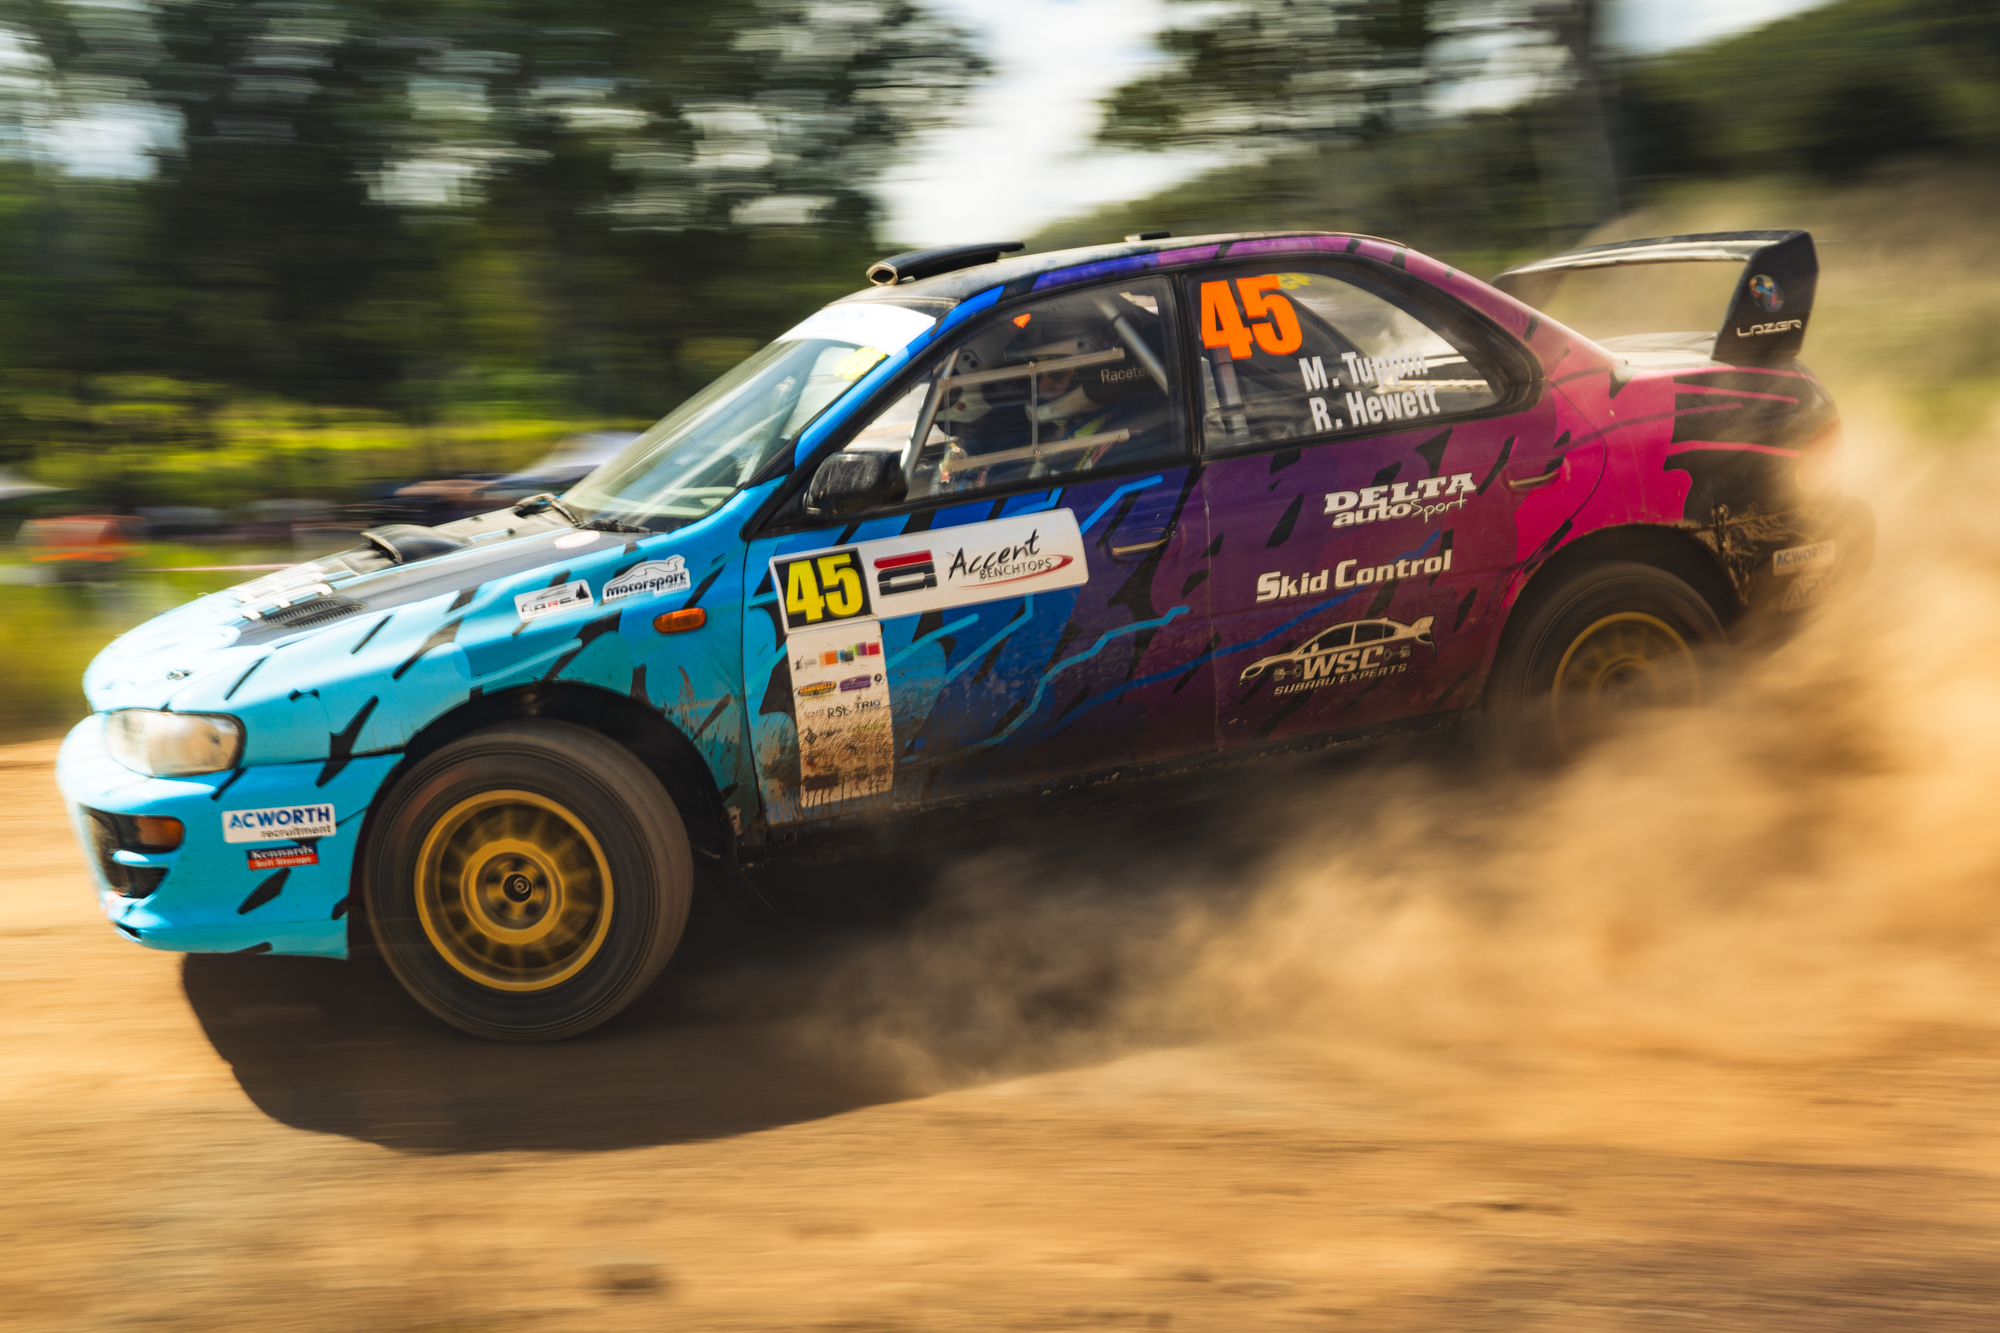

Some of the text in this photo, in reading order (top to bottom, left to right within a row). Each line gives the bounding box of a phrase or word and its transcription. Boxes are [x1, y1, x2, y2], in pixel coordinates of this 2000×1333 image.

[1200, 274, 1303, 360] 45
[1736, 319, 1802, 338] LAZER
[1299, 356, 1340, 393] M.
[1309, 382, 1440, 433] R. Hewett
[1323, 472, 1477, 515] DELTA
[948, 529, 1041, 581] Accent
[979, 557, 1053, 581] BENCHTOPS
[786, 552, 863, 623] 45
[1256, 549, 1453, 603] Skid Control
[1273, 663, 1408, 697] SUBARU EXPERTS
[1302, 645, 1385, 681] WSC
[228, 806, 331, 828] ACWORTH
[260, 825, 332, 839] recruitment
